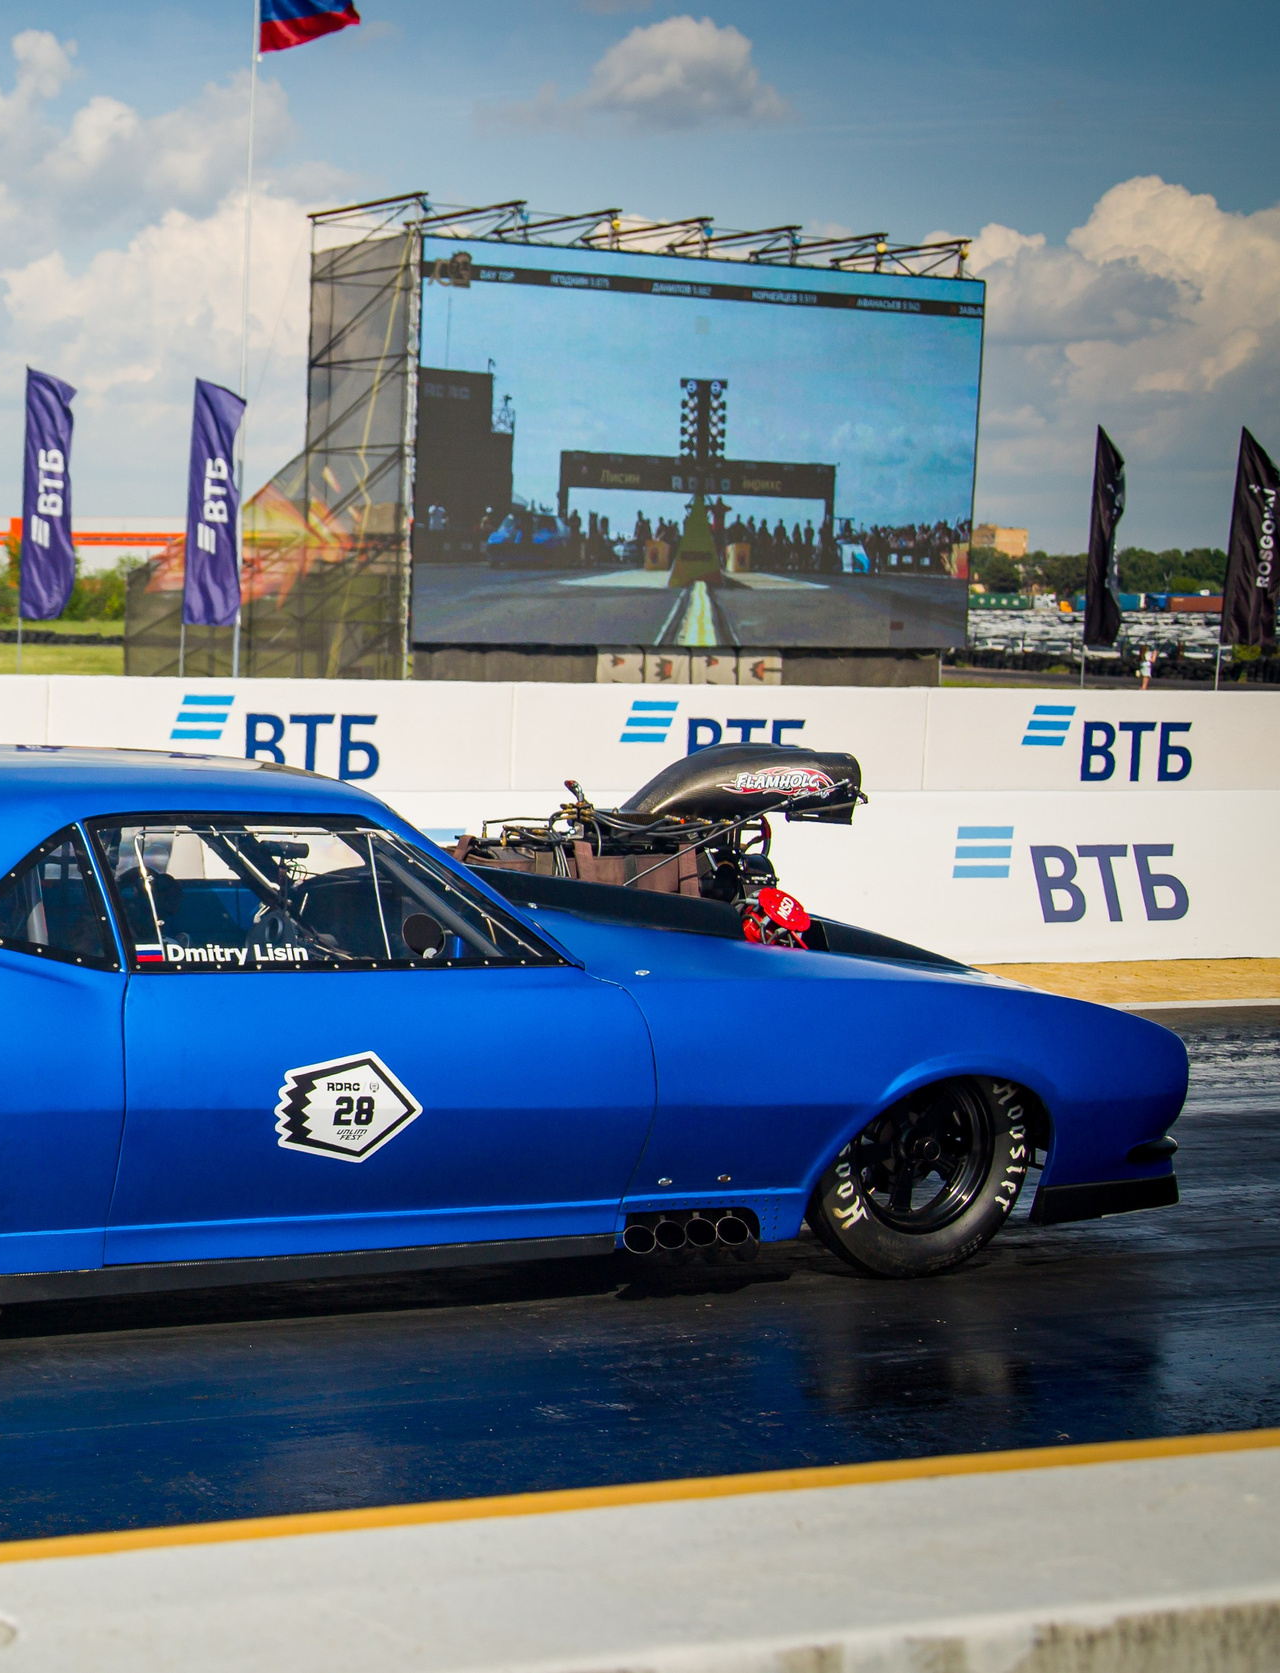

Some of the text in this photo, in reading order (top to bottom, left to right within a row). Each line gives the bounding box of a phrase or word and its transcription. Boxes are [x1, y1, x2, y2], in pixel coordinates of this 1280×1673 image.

[38, 448, 66, 517] ВТБ
[203, 457, 229, 524] ВТБ
[245, 713, 380, 781] ВТБ
[1080, 721, 1193, 782] ВТБ
[776, 896, 795, 921] MSD
[1029, 843, 1189, 923] ВТБ
[166, 943, 309, 966] Dmitry Lisin
[326, 1082, 361, 1092] RDRC
[332, 1096, 375, 1126] 28
